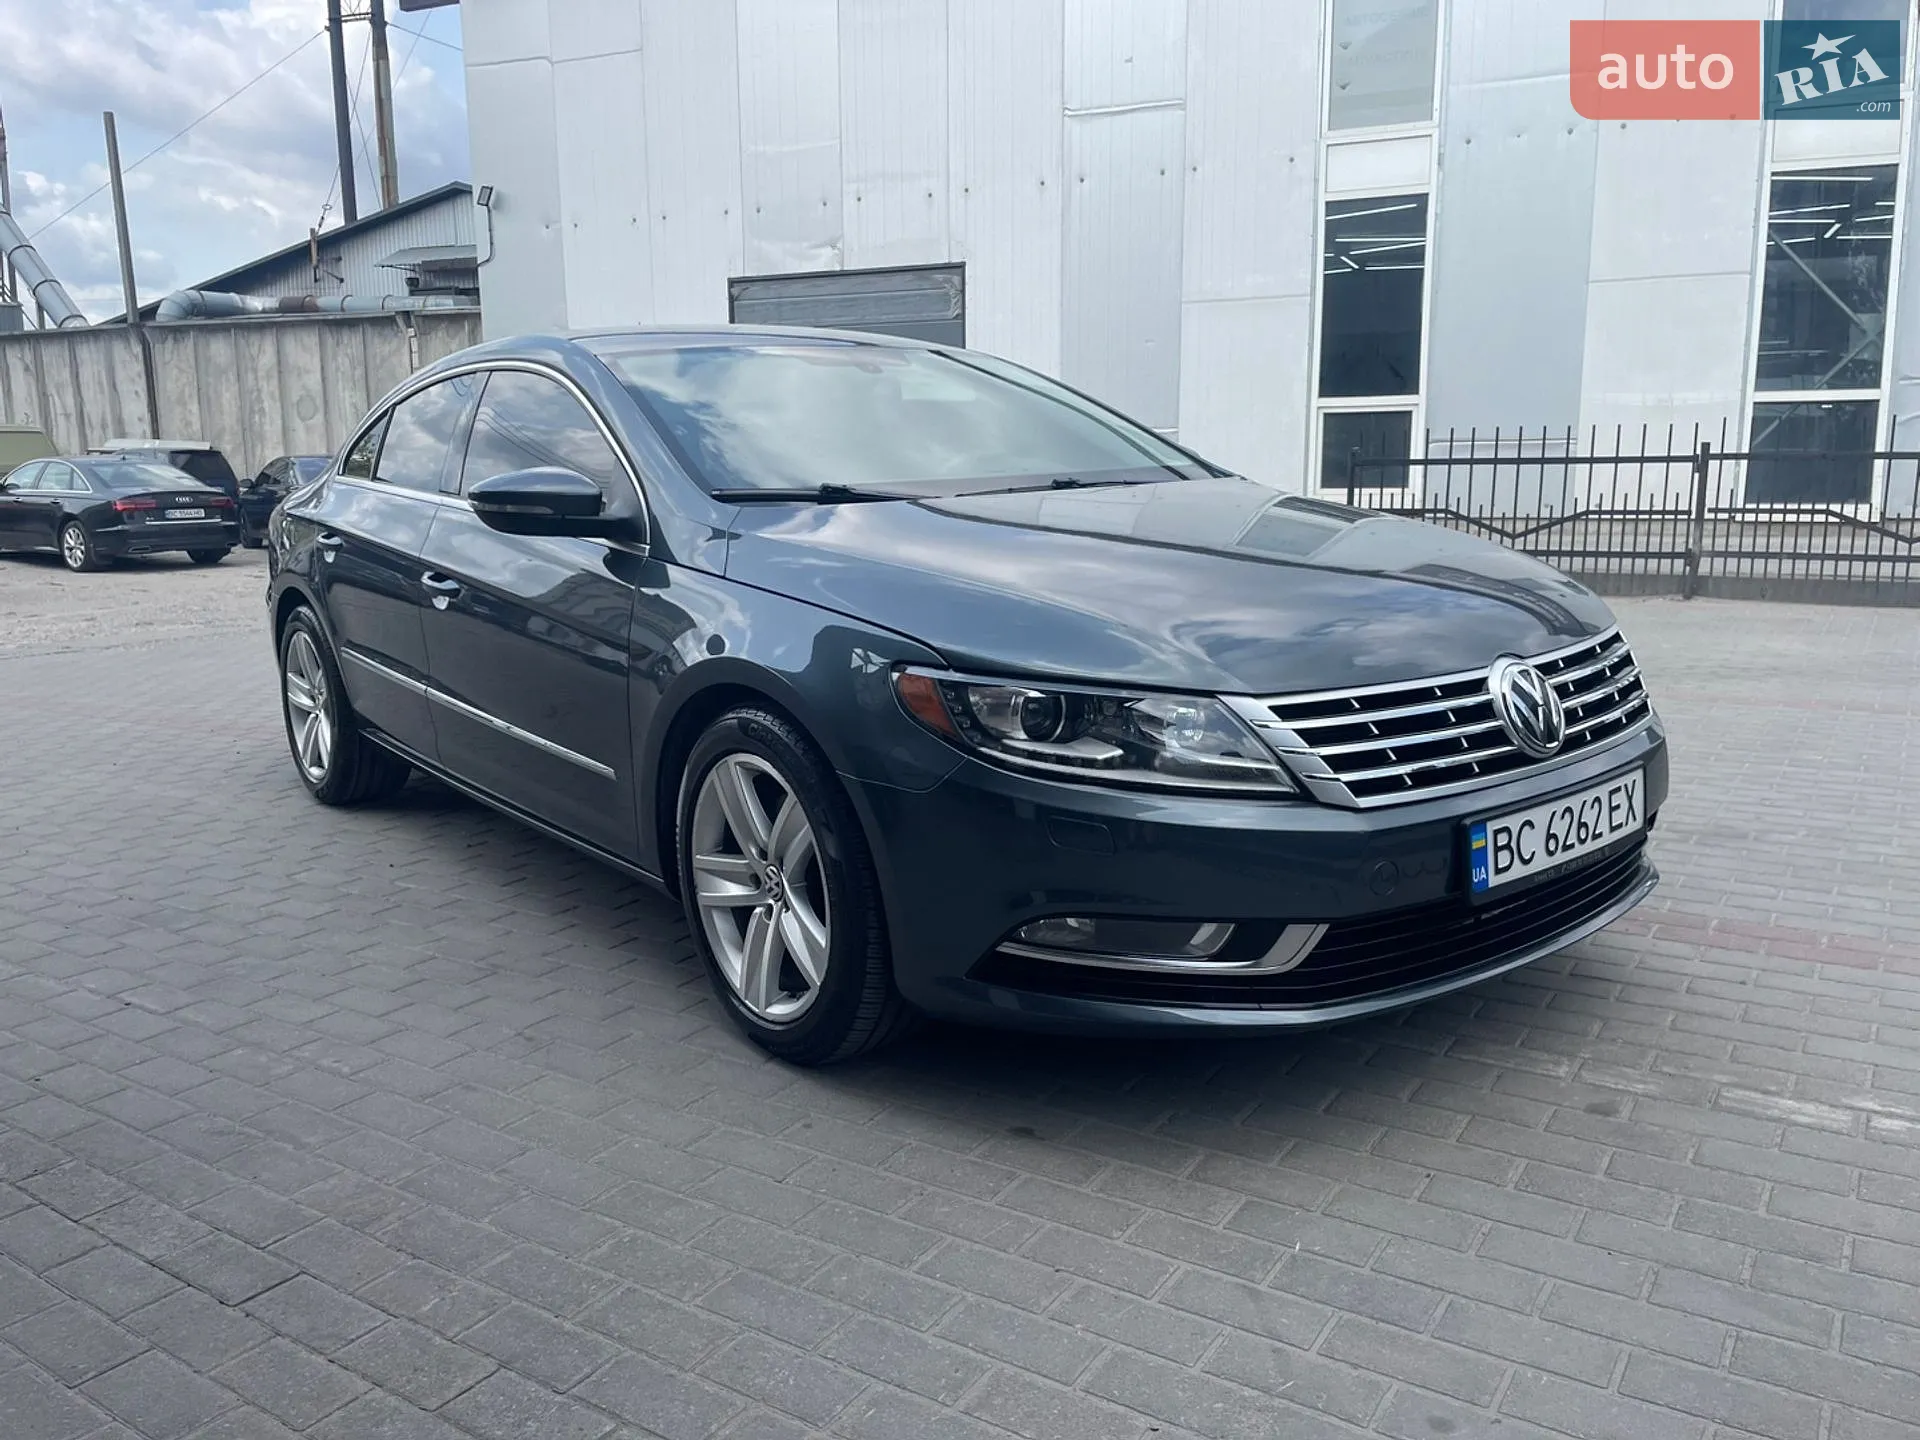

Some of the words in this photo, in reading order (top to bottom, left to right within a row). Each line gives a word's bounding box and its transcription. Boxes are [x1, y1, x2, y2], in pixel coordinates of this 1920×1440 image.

[1493, 818, 1536, 877] BC
[1545, 795, 1603, 858] 6262
[1607, 779, 1637, 834] EX
[1472, 866, 1488, 883] UA
